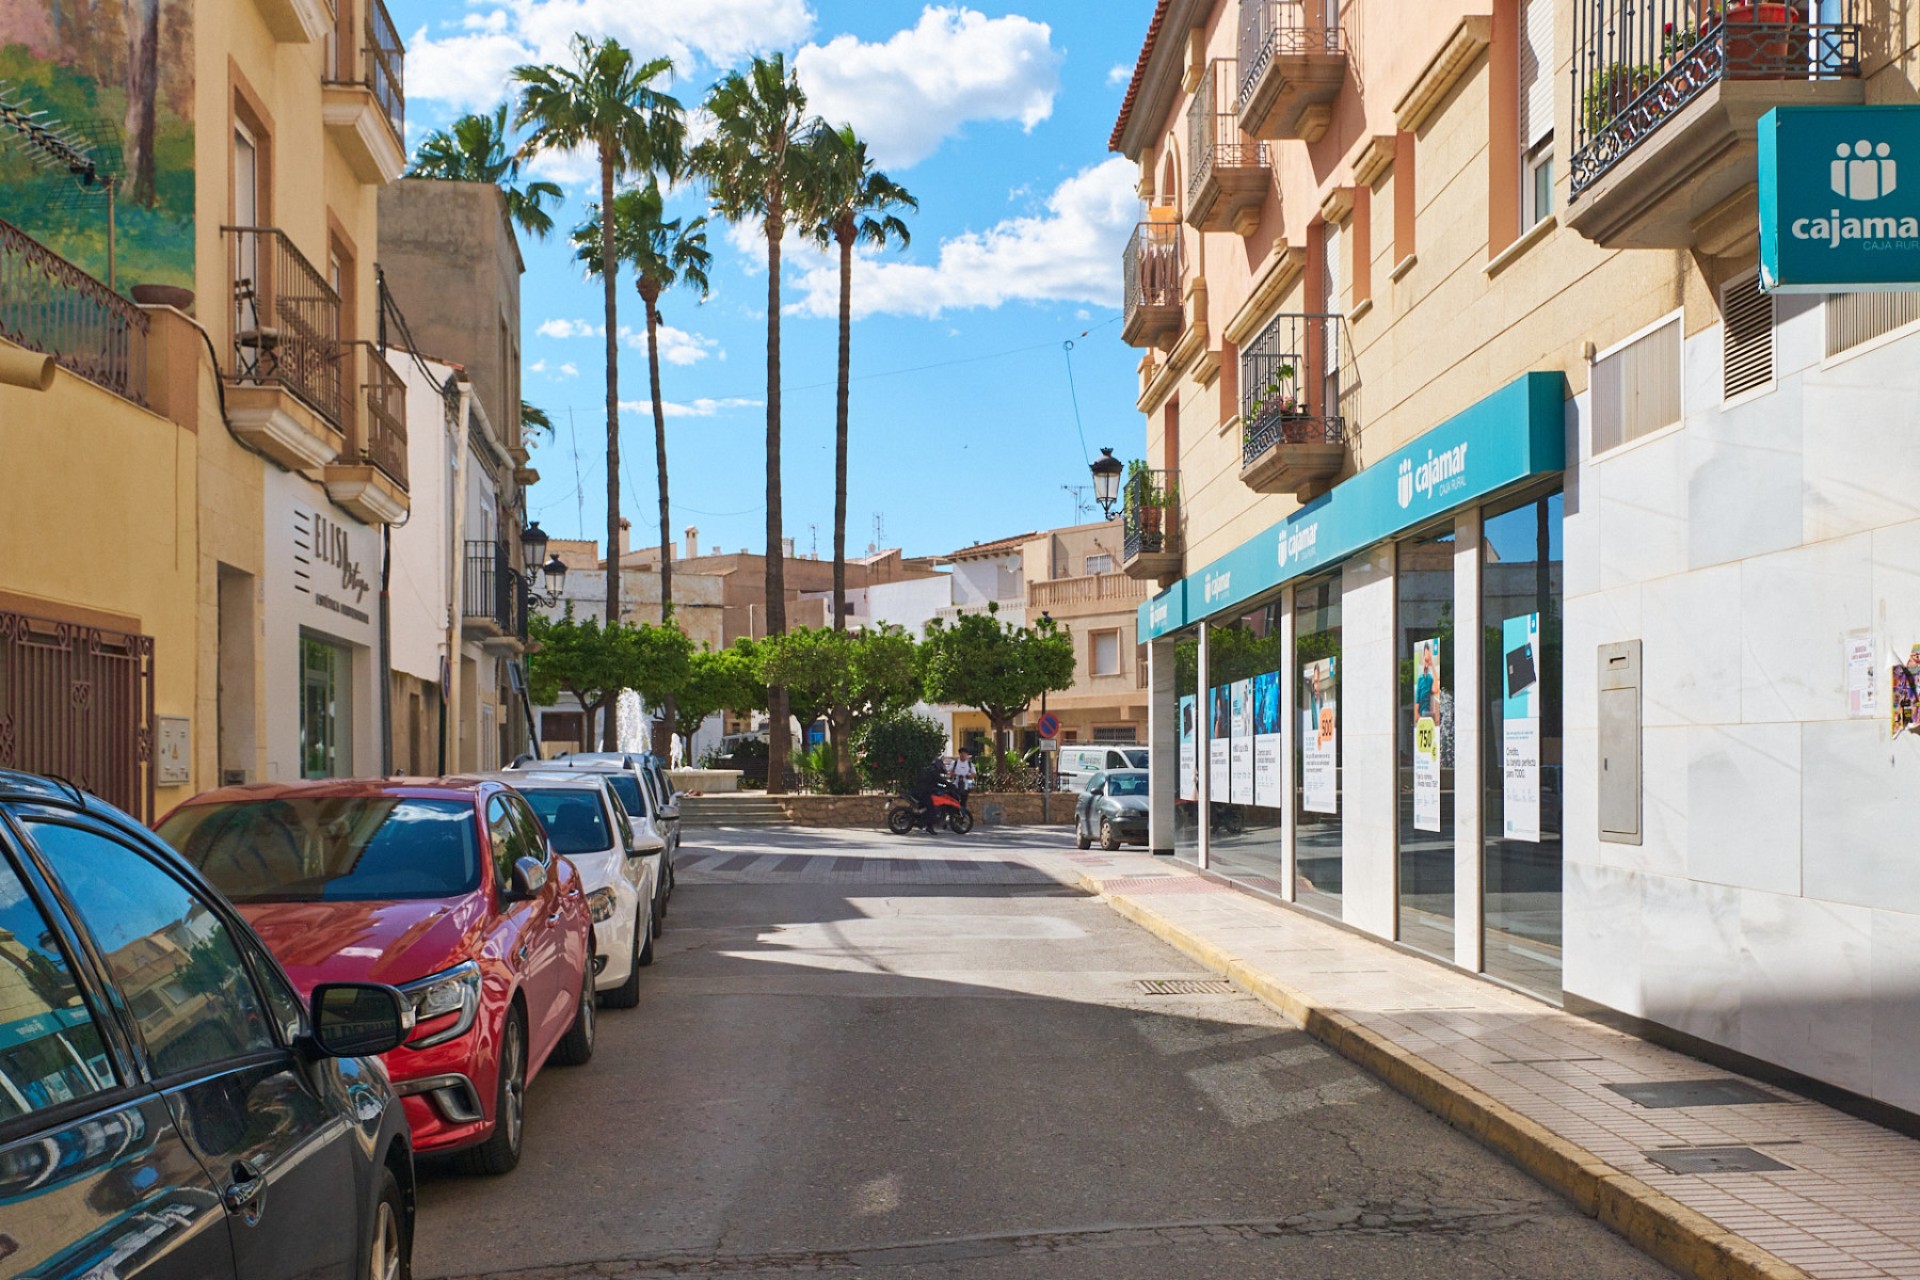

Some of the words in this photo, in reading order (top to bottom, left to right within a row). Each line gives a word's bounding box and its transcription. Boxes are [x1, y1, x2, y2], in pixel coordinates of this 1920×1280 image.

[1862, 240, 1893, 251] CAJA
[1414, 441, 1468, 500] cajamar
[314, 512, 350, 572] ELISA
